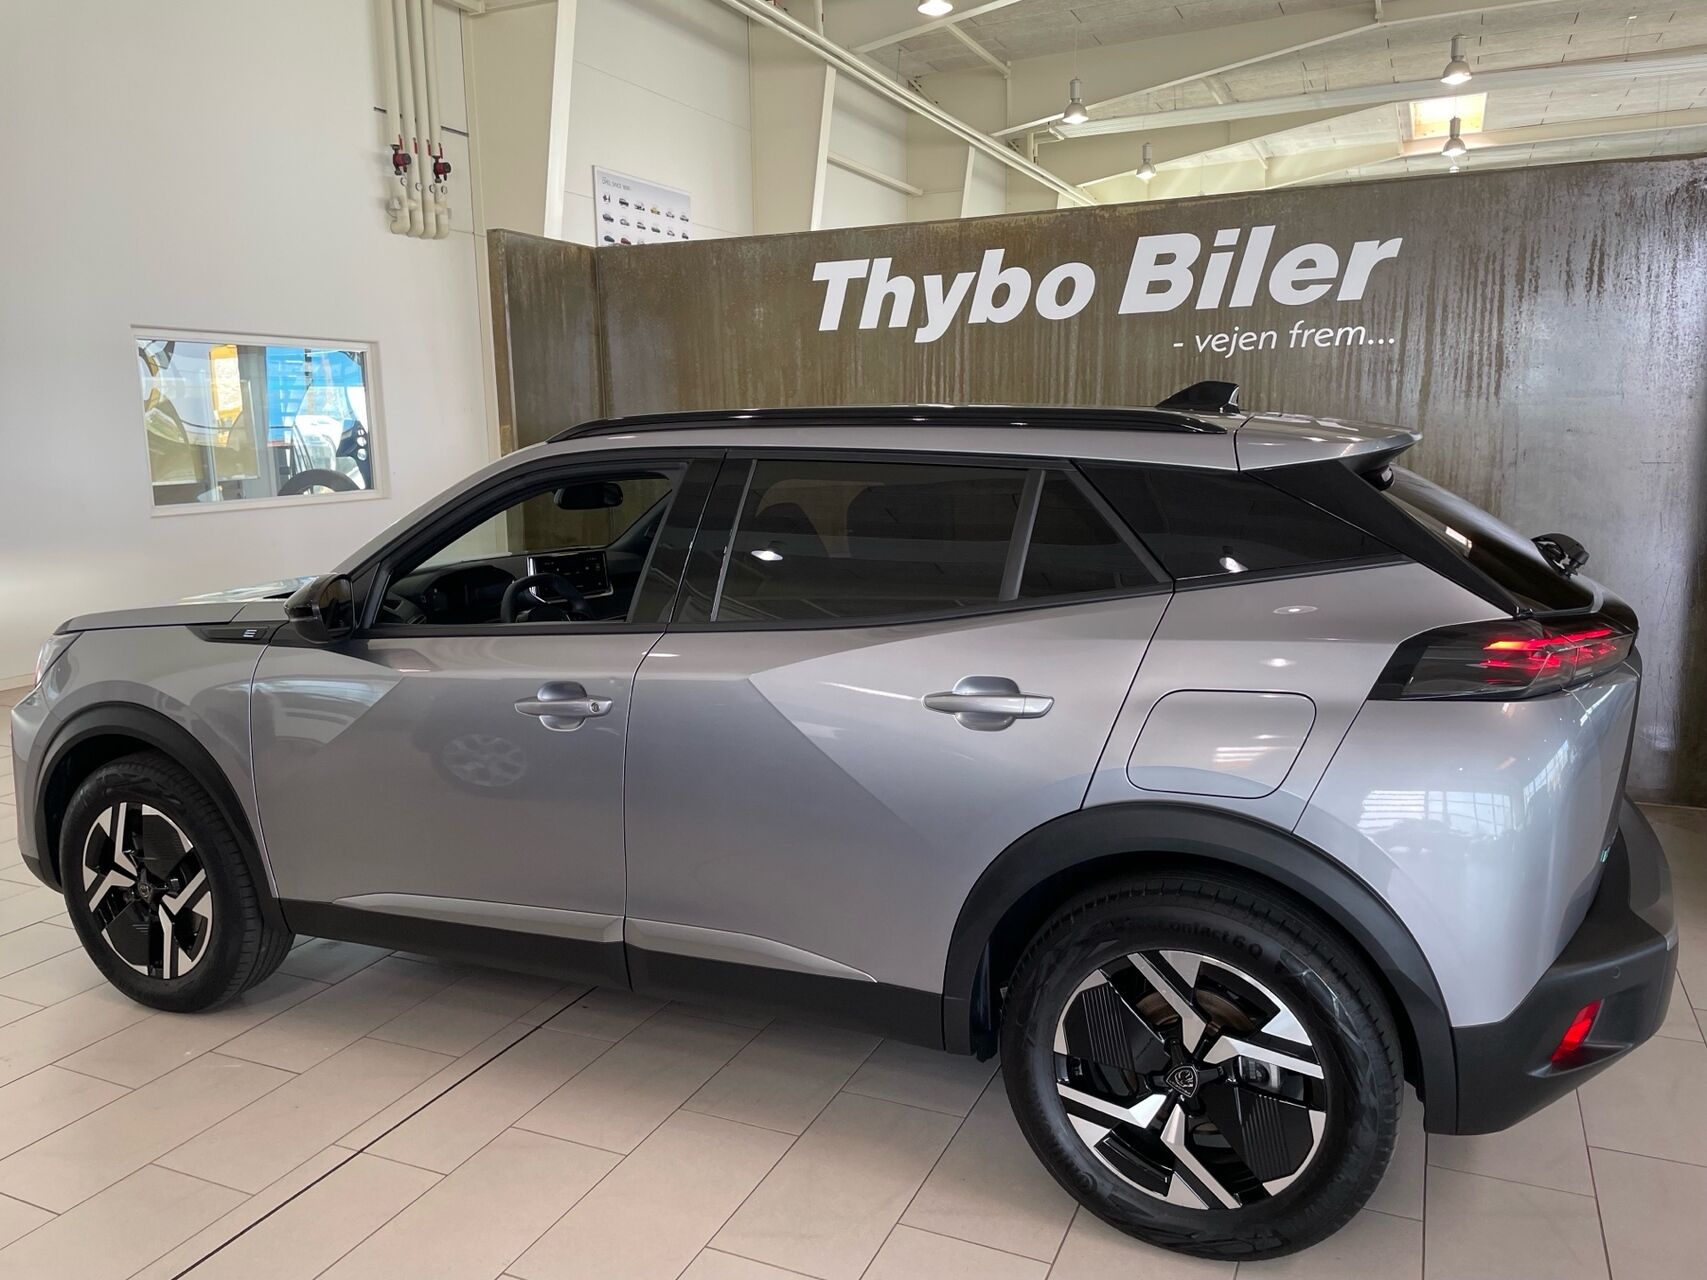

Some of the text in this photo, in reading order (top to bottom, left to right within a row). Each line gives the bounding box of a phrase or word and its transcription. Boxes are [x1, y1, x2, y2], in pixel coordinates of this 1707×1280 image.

[812, 224, 1403, 344] Thybo Biler
[1195, 326, 1278, 359] vejen
[1288, 319, 1396, 349] frem...
